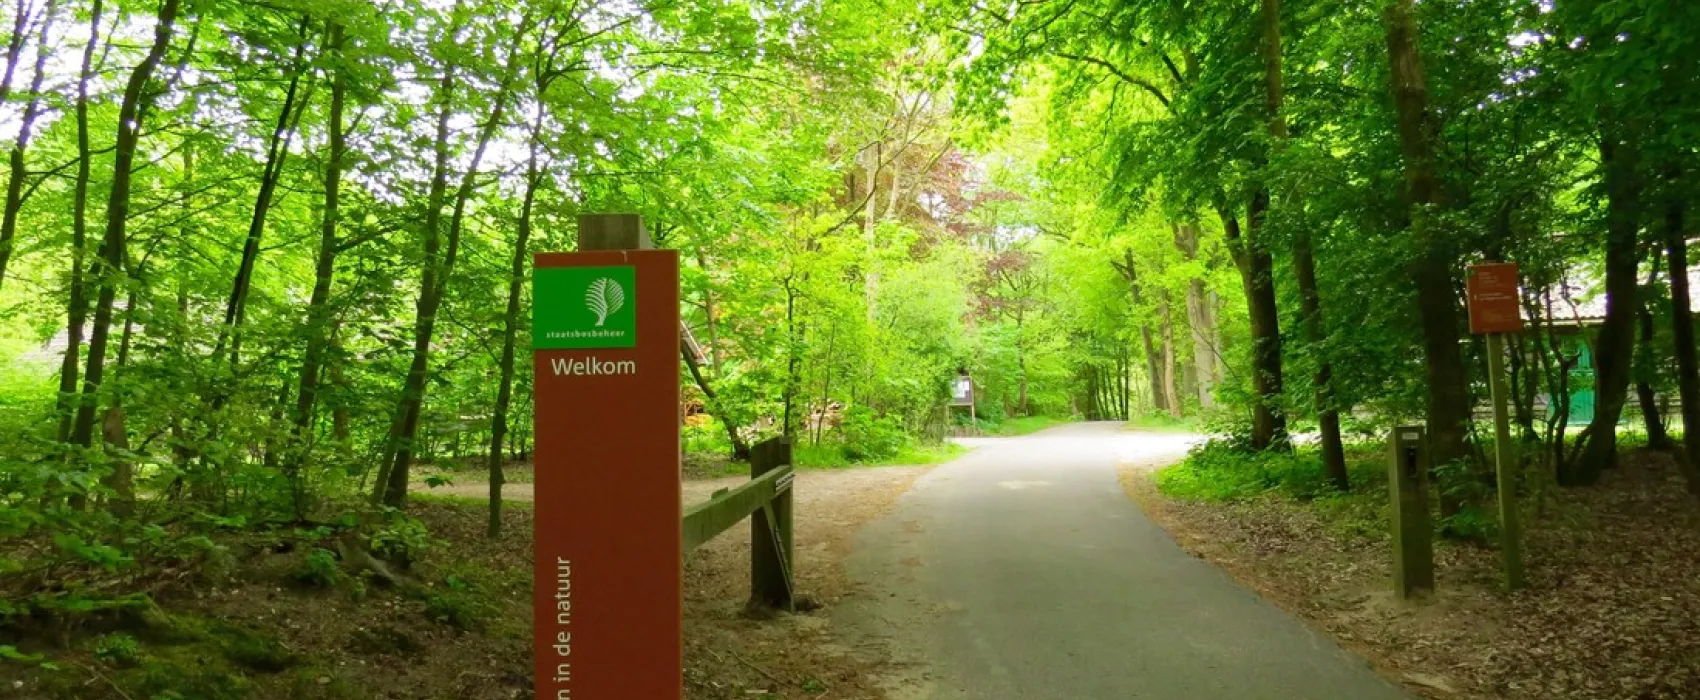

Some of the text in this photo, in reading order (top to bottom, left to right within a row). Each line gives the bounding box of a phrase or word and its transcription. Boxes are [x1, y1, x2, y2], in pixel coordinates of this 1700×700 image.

[546, 329, 625, 339] staatsbosbeheer
[551, 356, 636, 376] Welkom
[554, 556, 571, 624] natuur
[552, 631, 571, 656] de
[552, 663, 571, 683] in
